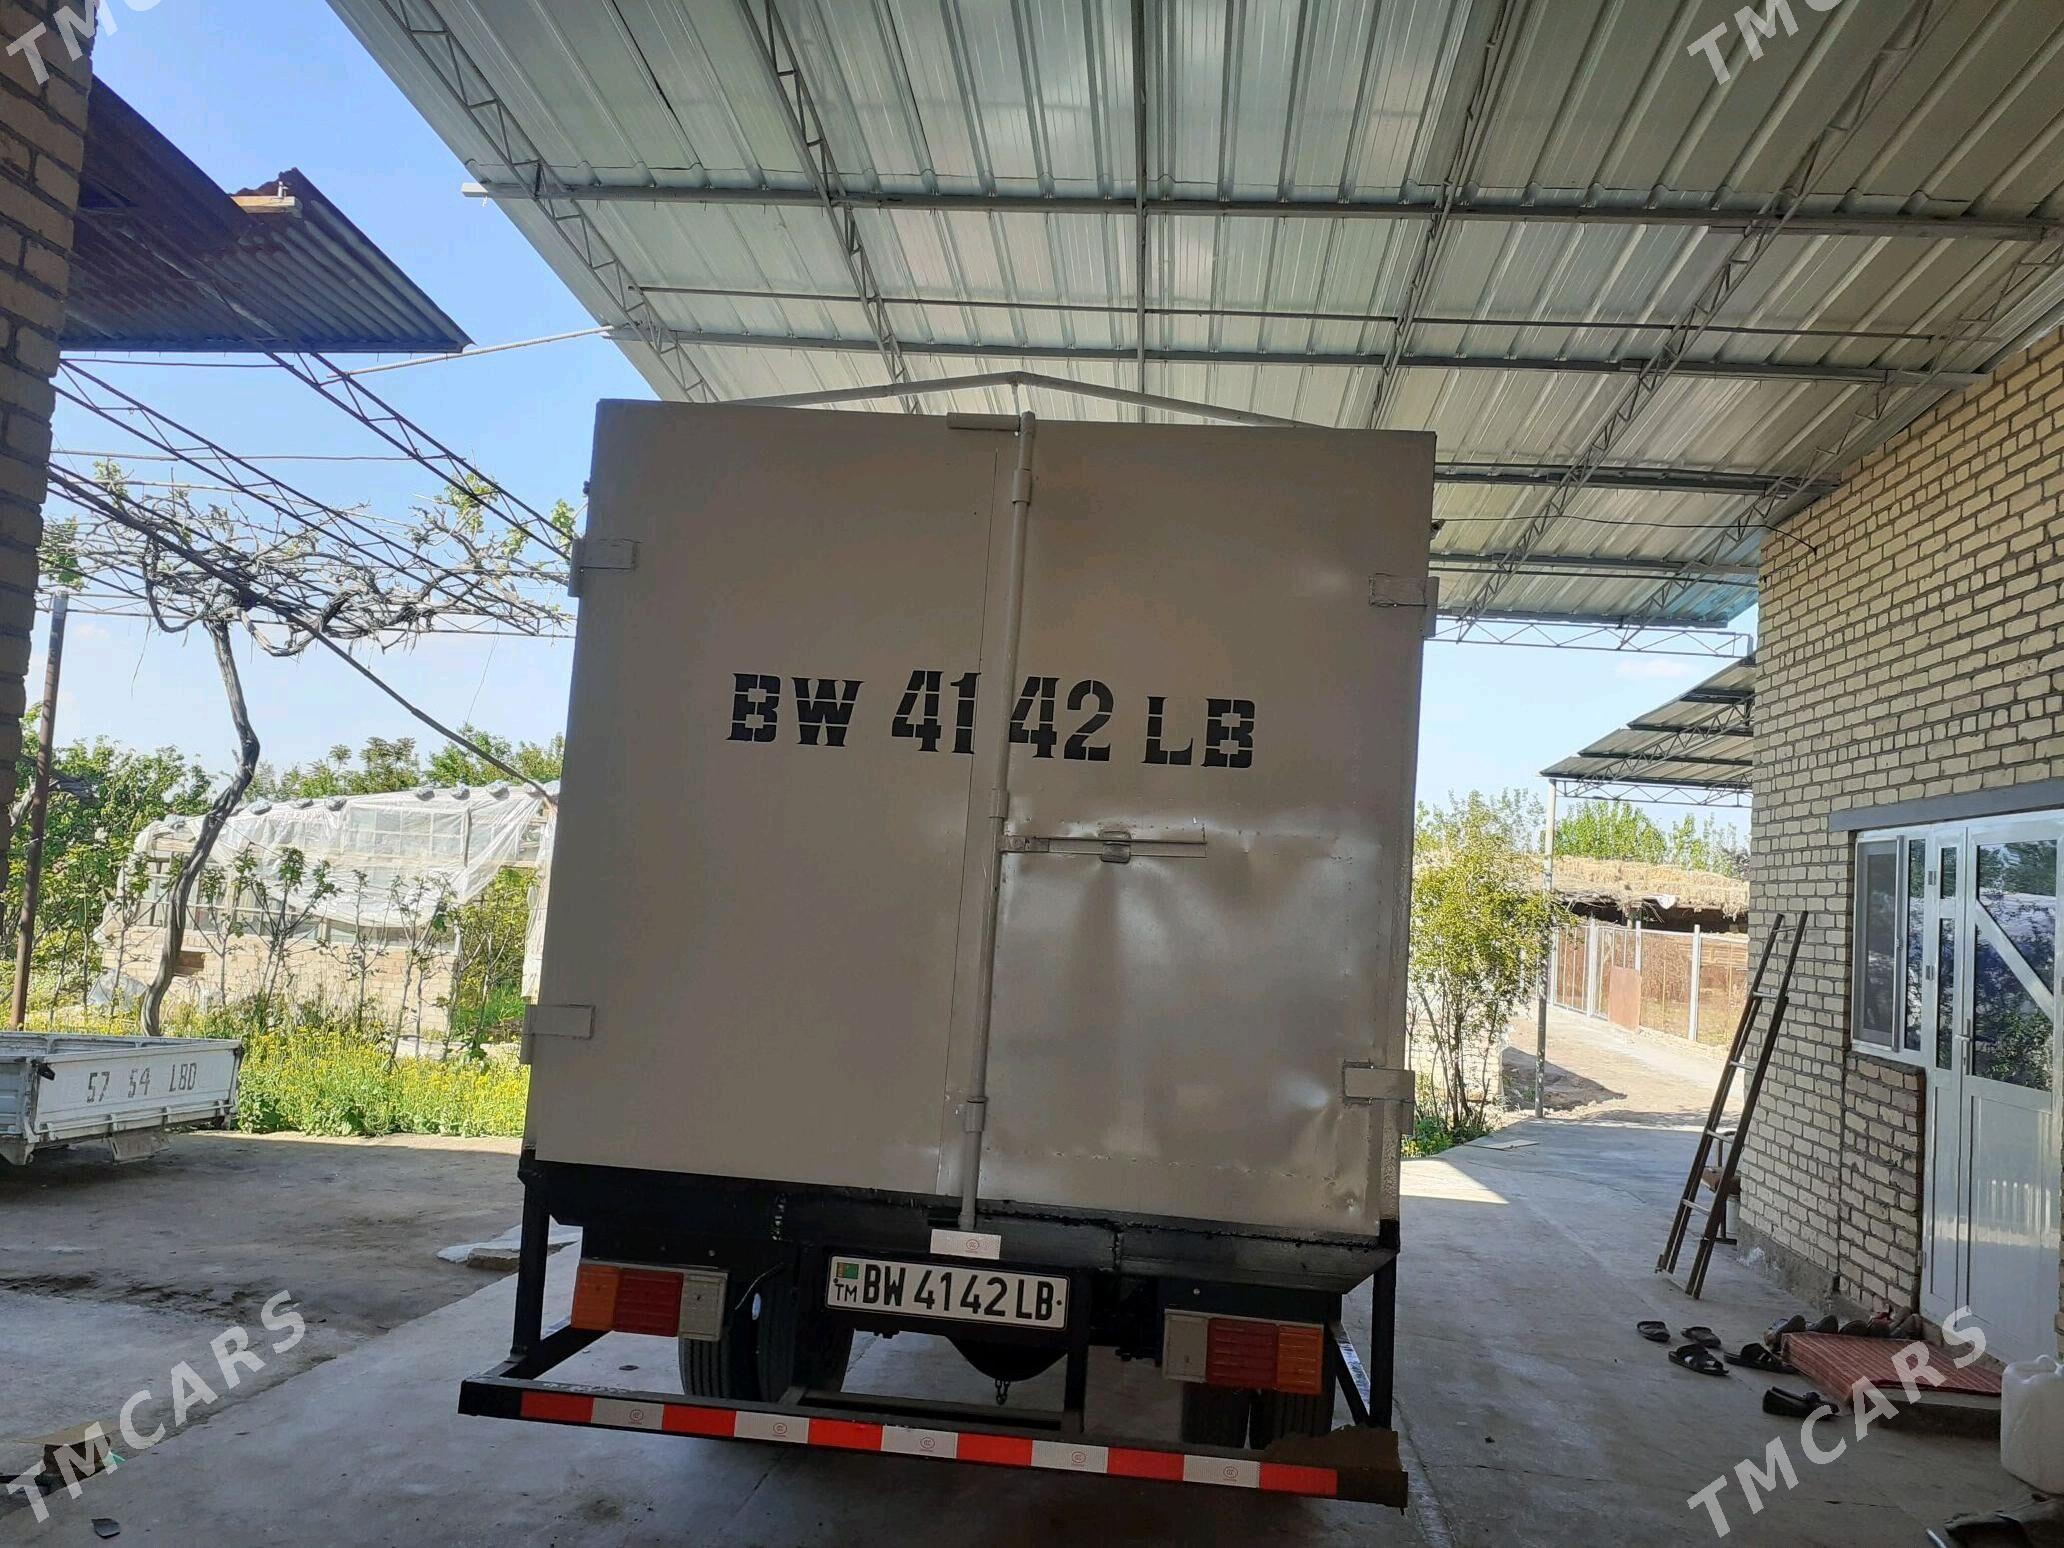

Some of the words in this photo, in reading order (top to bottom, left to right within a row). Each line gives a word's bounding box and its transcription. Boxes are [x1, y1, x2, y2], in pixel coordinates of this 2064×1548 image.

[726, 673, 864, 747] BW
[1141, 696, 1256, 768] LB
[86, 1071, 111, 1103] 57
[127, 1067, 151, 1098] 54
[834, 1283, 858, 1302] TM
[863, 1264, 906, 1306] BW
[1016, 1279, 1055, 1320] LB
